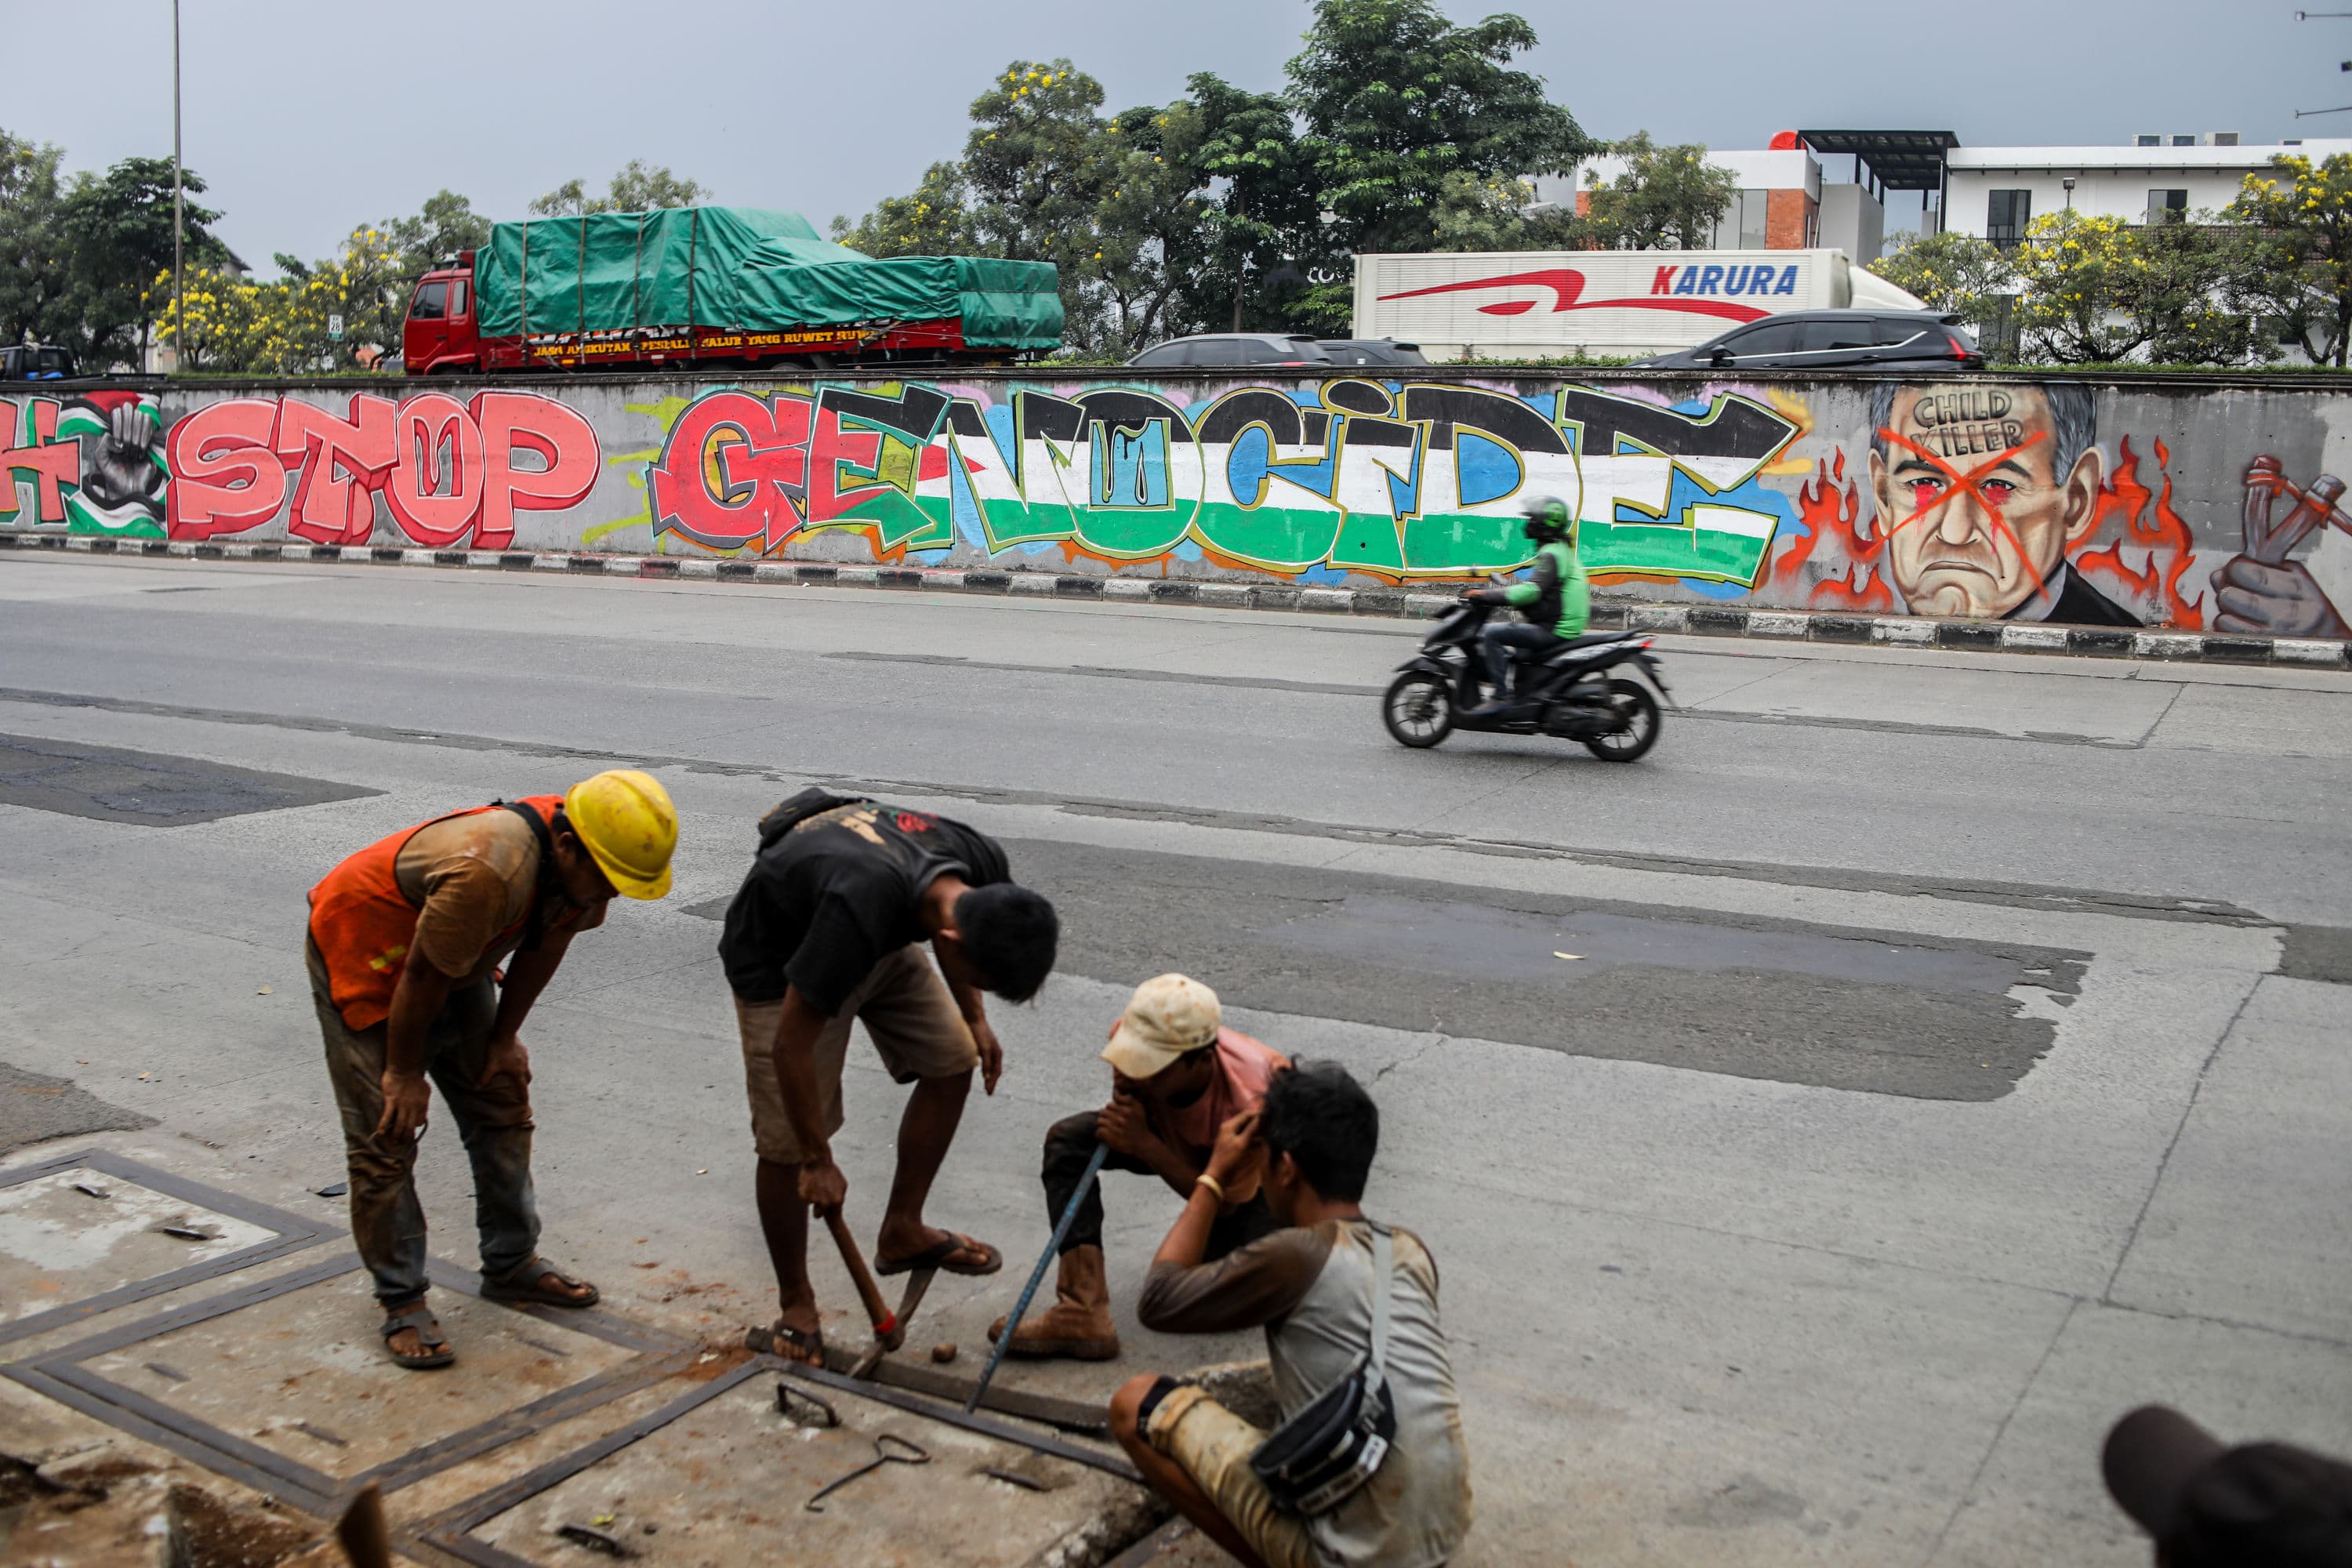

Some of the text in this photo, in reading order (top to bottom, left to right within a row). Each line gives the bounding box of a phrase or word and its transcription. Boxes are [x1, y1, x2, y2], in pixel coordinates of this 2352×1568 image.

[1650, 265, 1798, 296] KARURA
[533, 345, 564, 357] JASA
[746, 334, 780, 345] YANG
[784, 332, 833, 343] RUWET
[1913, 390, 2013, 428] CHILD
[1910, 419, 2025, 463] KILLER
[167, 392, 601, 549] STOP
